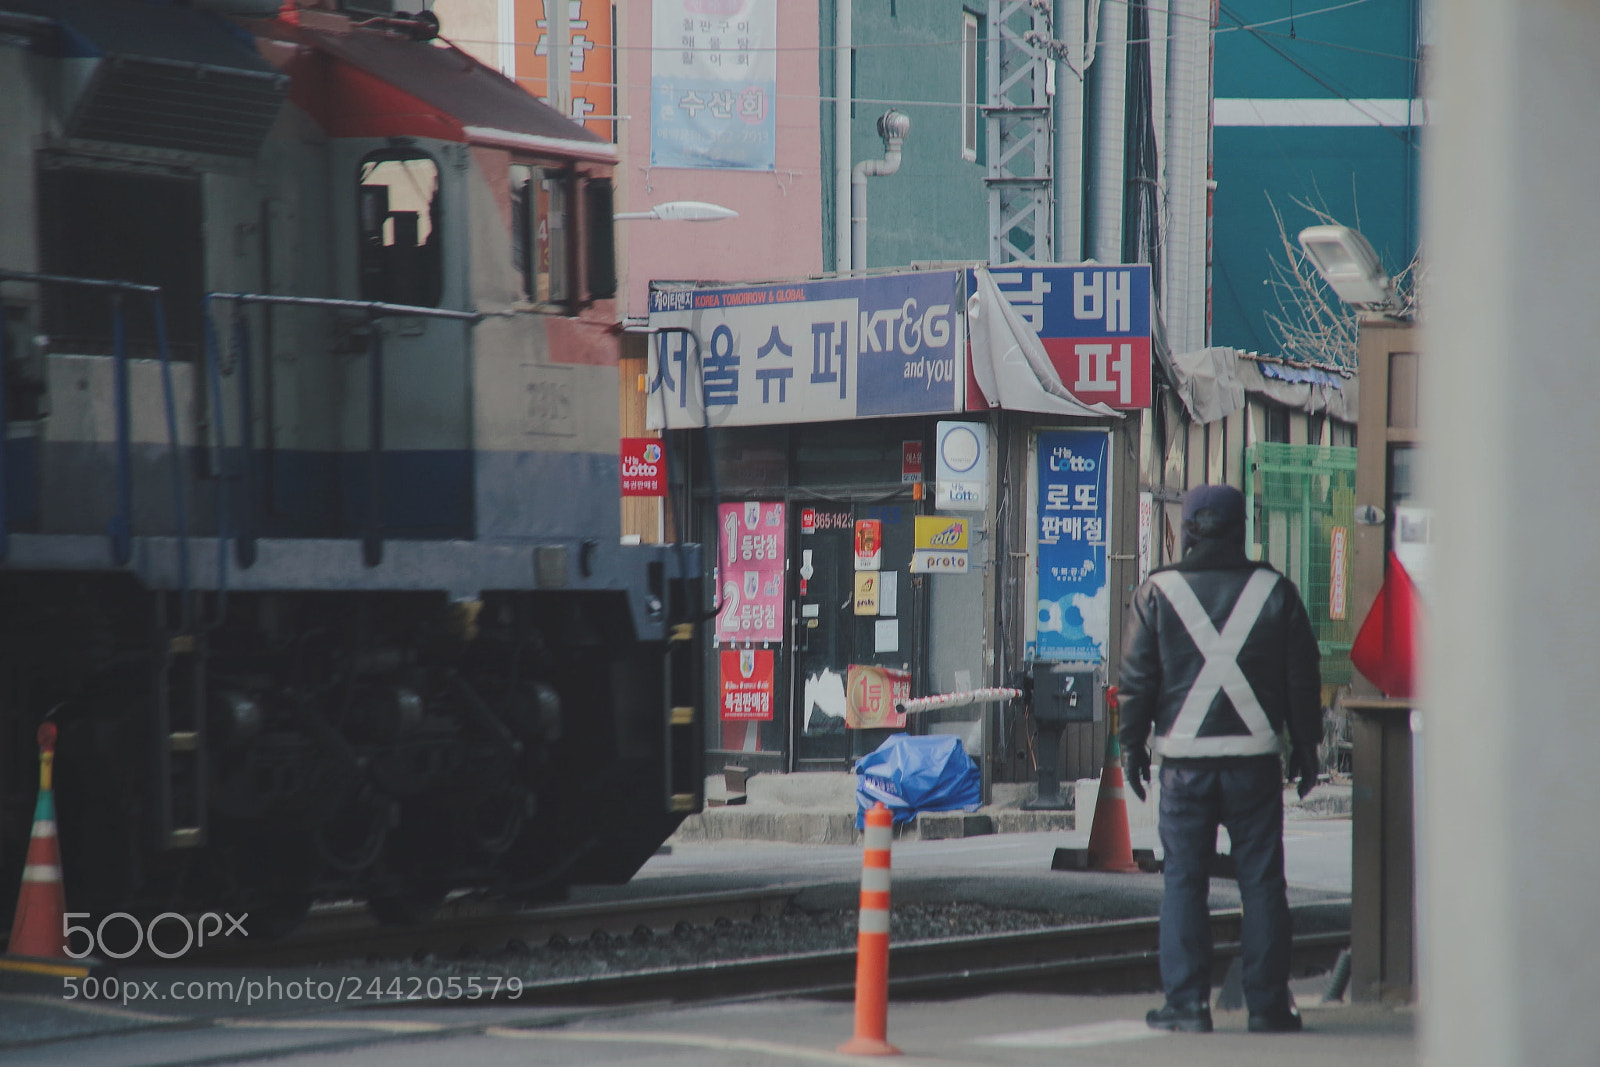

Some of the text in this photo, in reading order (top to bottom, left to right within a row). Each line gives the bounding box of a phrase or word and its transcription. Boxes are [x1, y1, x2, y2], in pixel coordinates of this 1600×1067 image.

[679, 89, 765, 121] 수산회
[695, 296, 719, 308] KOREA
[722, 291, 766, 306] TOMORROW
[768, 291, 774, 302] &
[776, 288, 805, 302] GLOBAL
[859, 297, 951, 356] KT&G
[652, 321, 848, 408] 서울슈퍼
[904, 356, 954, 390] and you
[622, 463, 658, 477] Lotto
[1050, 455, 1096, 472] Lotto
[950, 490, 980, 502] Lotto
[1045, 484, 1098, 510] 로또
[1041, 516, 1103, 542] 판매점
[927, 556, 965, 569] proto
[859, 675, 882, 713] 1등
